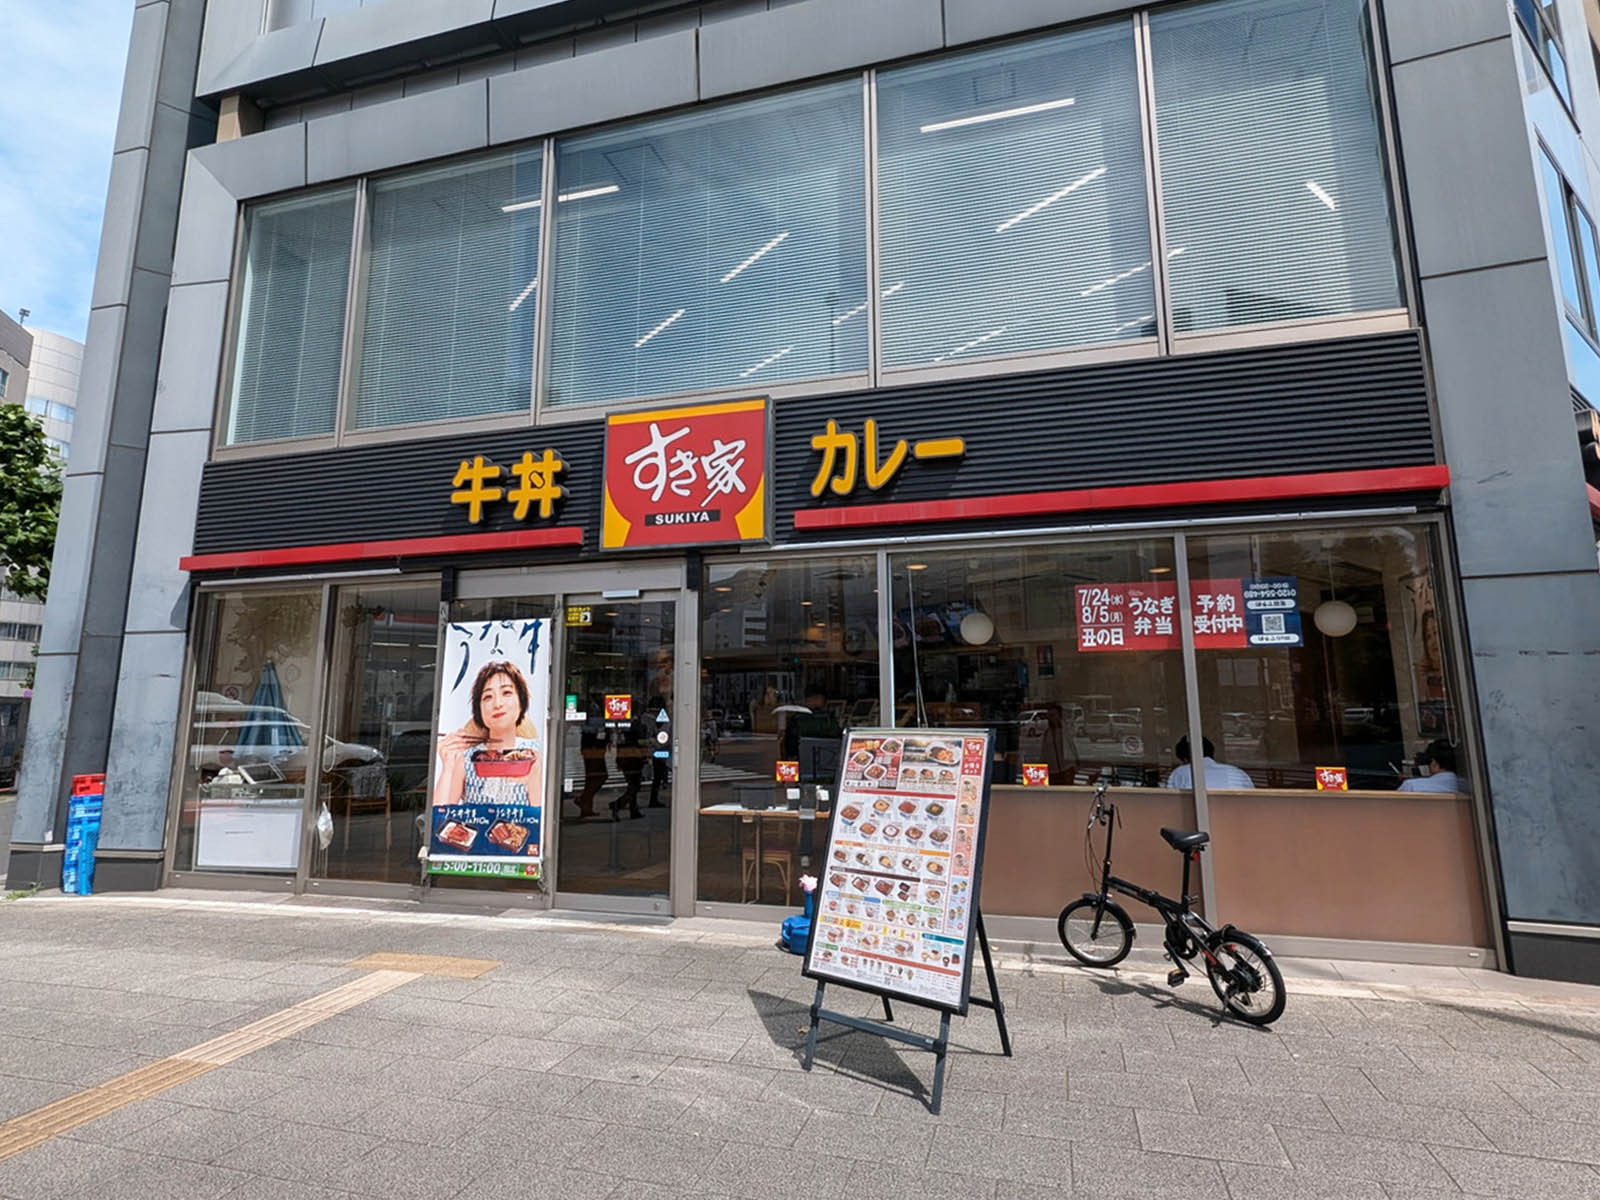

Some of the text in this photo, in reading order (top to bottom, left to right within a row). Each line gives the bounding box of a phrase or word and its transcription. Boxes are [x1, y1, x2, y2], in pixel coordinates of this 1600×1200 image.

[624, 422, 746, 508] すき家
[811, 418, 965, 497] カレー
[450, 449, 564, 524] 牛丼
[654, 510, 711, 526] SUKIYA
[1128, 595, 1176, 616] うなぎ
[1195, 593, 1236, 613] 予約
[1081, 606, 1124, 624] 8/5(月)
[1193, 614, 1244, 635] 受付中
[1133, 616, 1173, 636] 弁当
[1081, 628, 1124, 647] 丑の日
